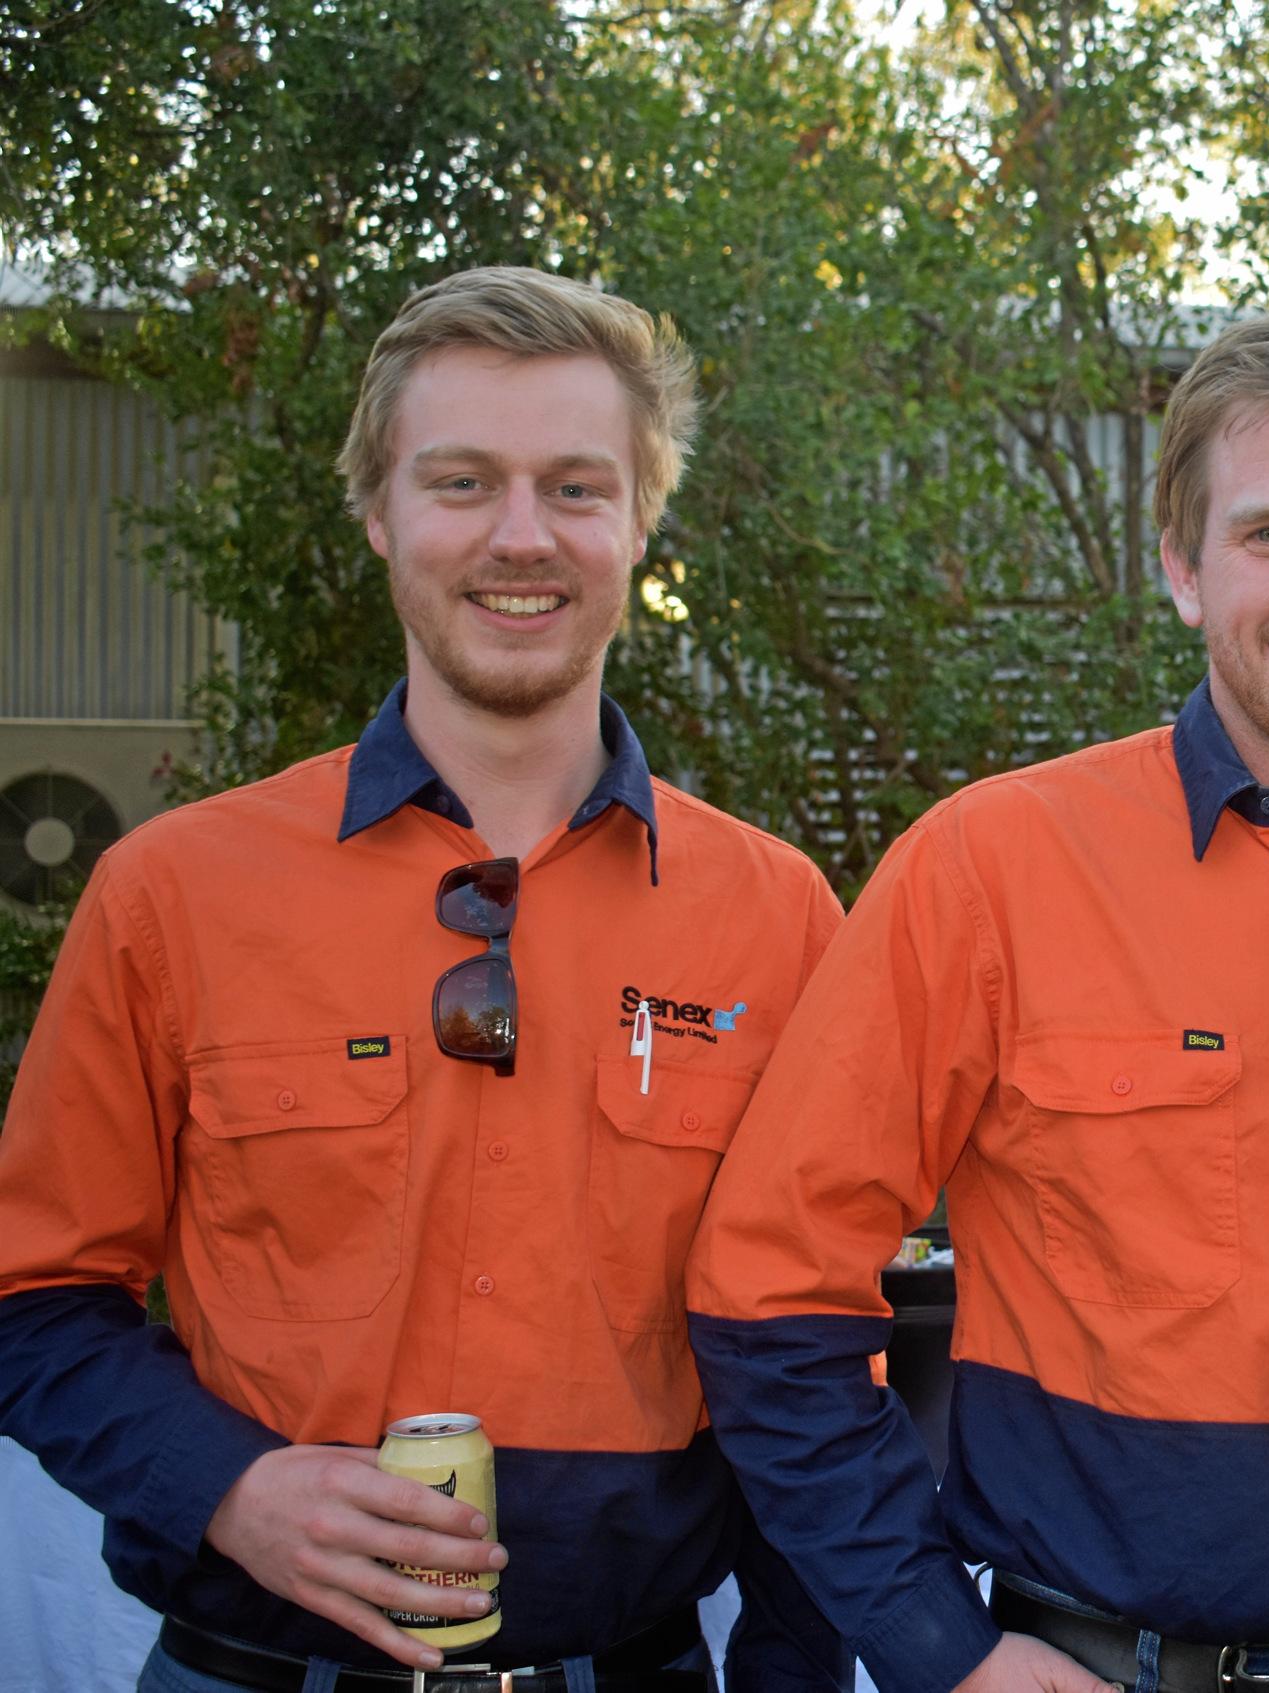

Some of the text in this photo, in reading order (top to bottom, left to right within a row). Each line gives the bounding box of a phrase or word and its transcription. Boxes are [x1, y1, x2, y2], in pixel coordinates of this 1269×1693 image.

[620, 985, 713, 1028] Senex
[654, 1022, 686, 1038] Energy
[687, 1026, 718, 1044] Limited
[1188, 1034, 1220, 1049] Bisley
[351, 1042, 385, 1055] Bisley
